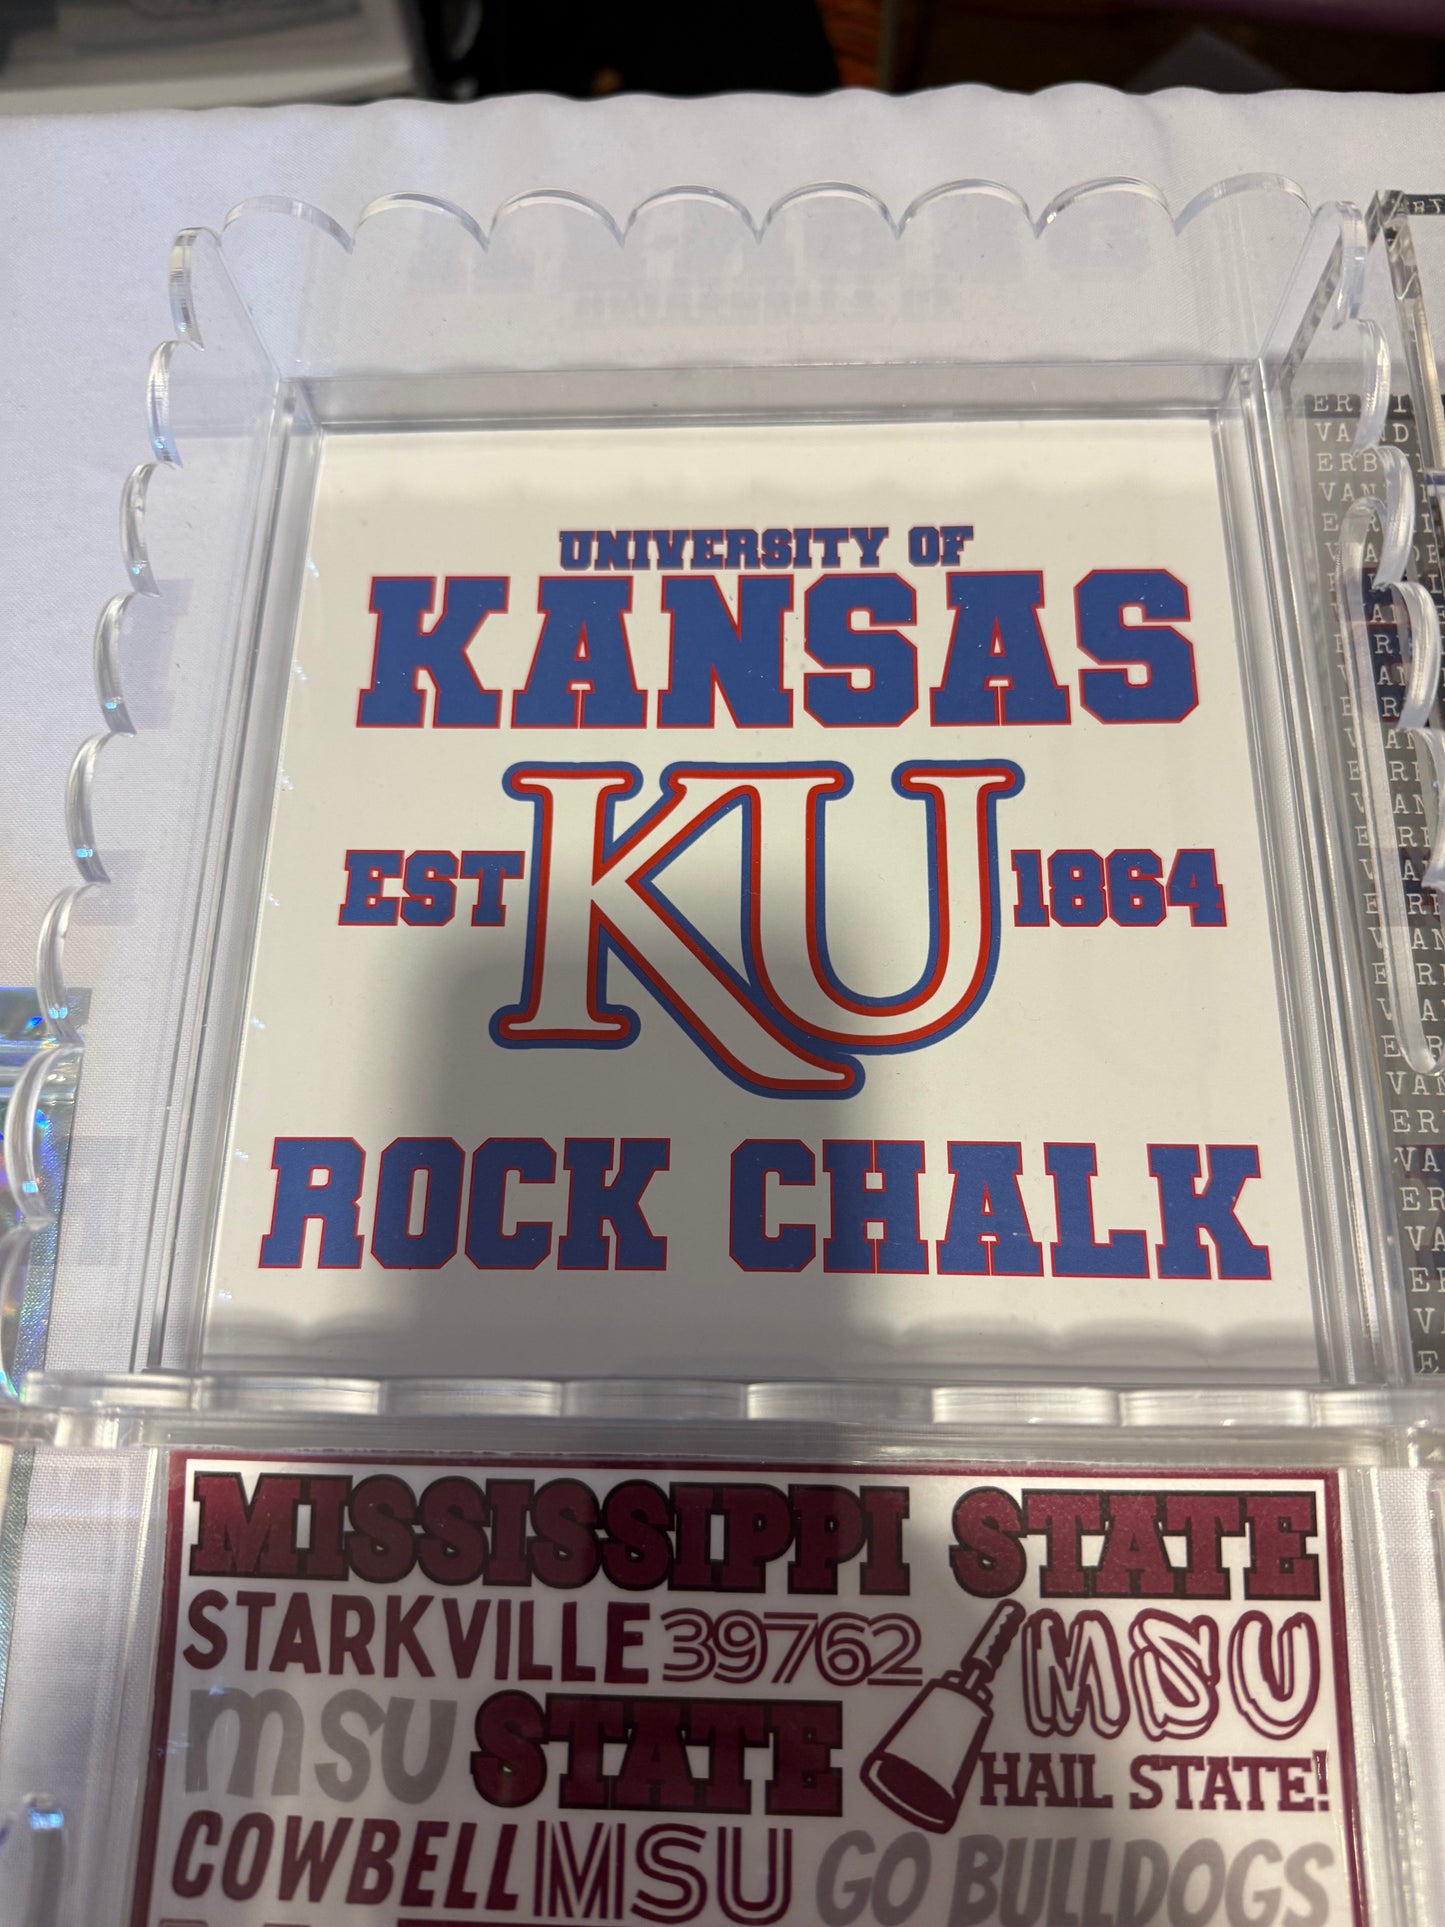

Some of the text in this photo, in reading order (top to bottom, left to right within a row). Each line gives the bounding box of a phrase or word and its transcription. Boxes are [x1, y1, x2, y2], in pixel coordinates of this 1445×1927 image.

[559, 525, 974, 570] UNIVERSITY OF
[356, 568, 1200, 729] KANSAS
[338, 849, 525, 926] EST
[488, 759, 1026, 1100] KU
[1010, 849, 1229, 927] 1864
[257, 1136, 1273, 1281] ROCK CHALK
[189, 1471, 1321, 1601] MISSISSIPPI STATE
[182, 1589, 923, 1687] STARKVILLE 39762
[1020, 1608, 1321, 1741] MSU
[470, 1690, 843, 1817] STATE
[979, 1750, 1330, 1812] HAIL STATE!
[171, 1809, 518, 1912] COWBELL
[533, 1820, 793, 1926] MSU
[816, 1829, 1335, 1927] GO BULLDOGS
